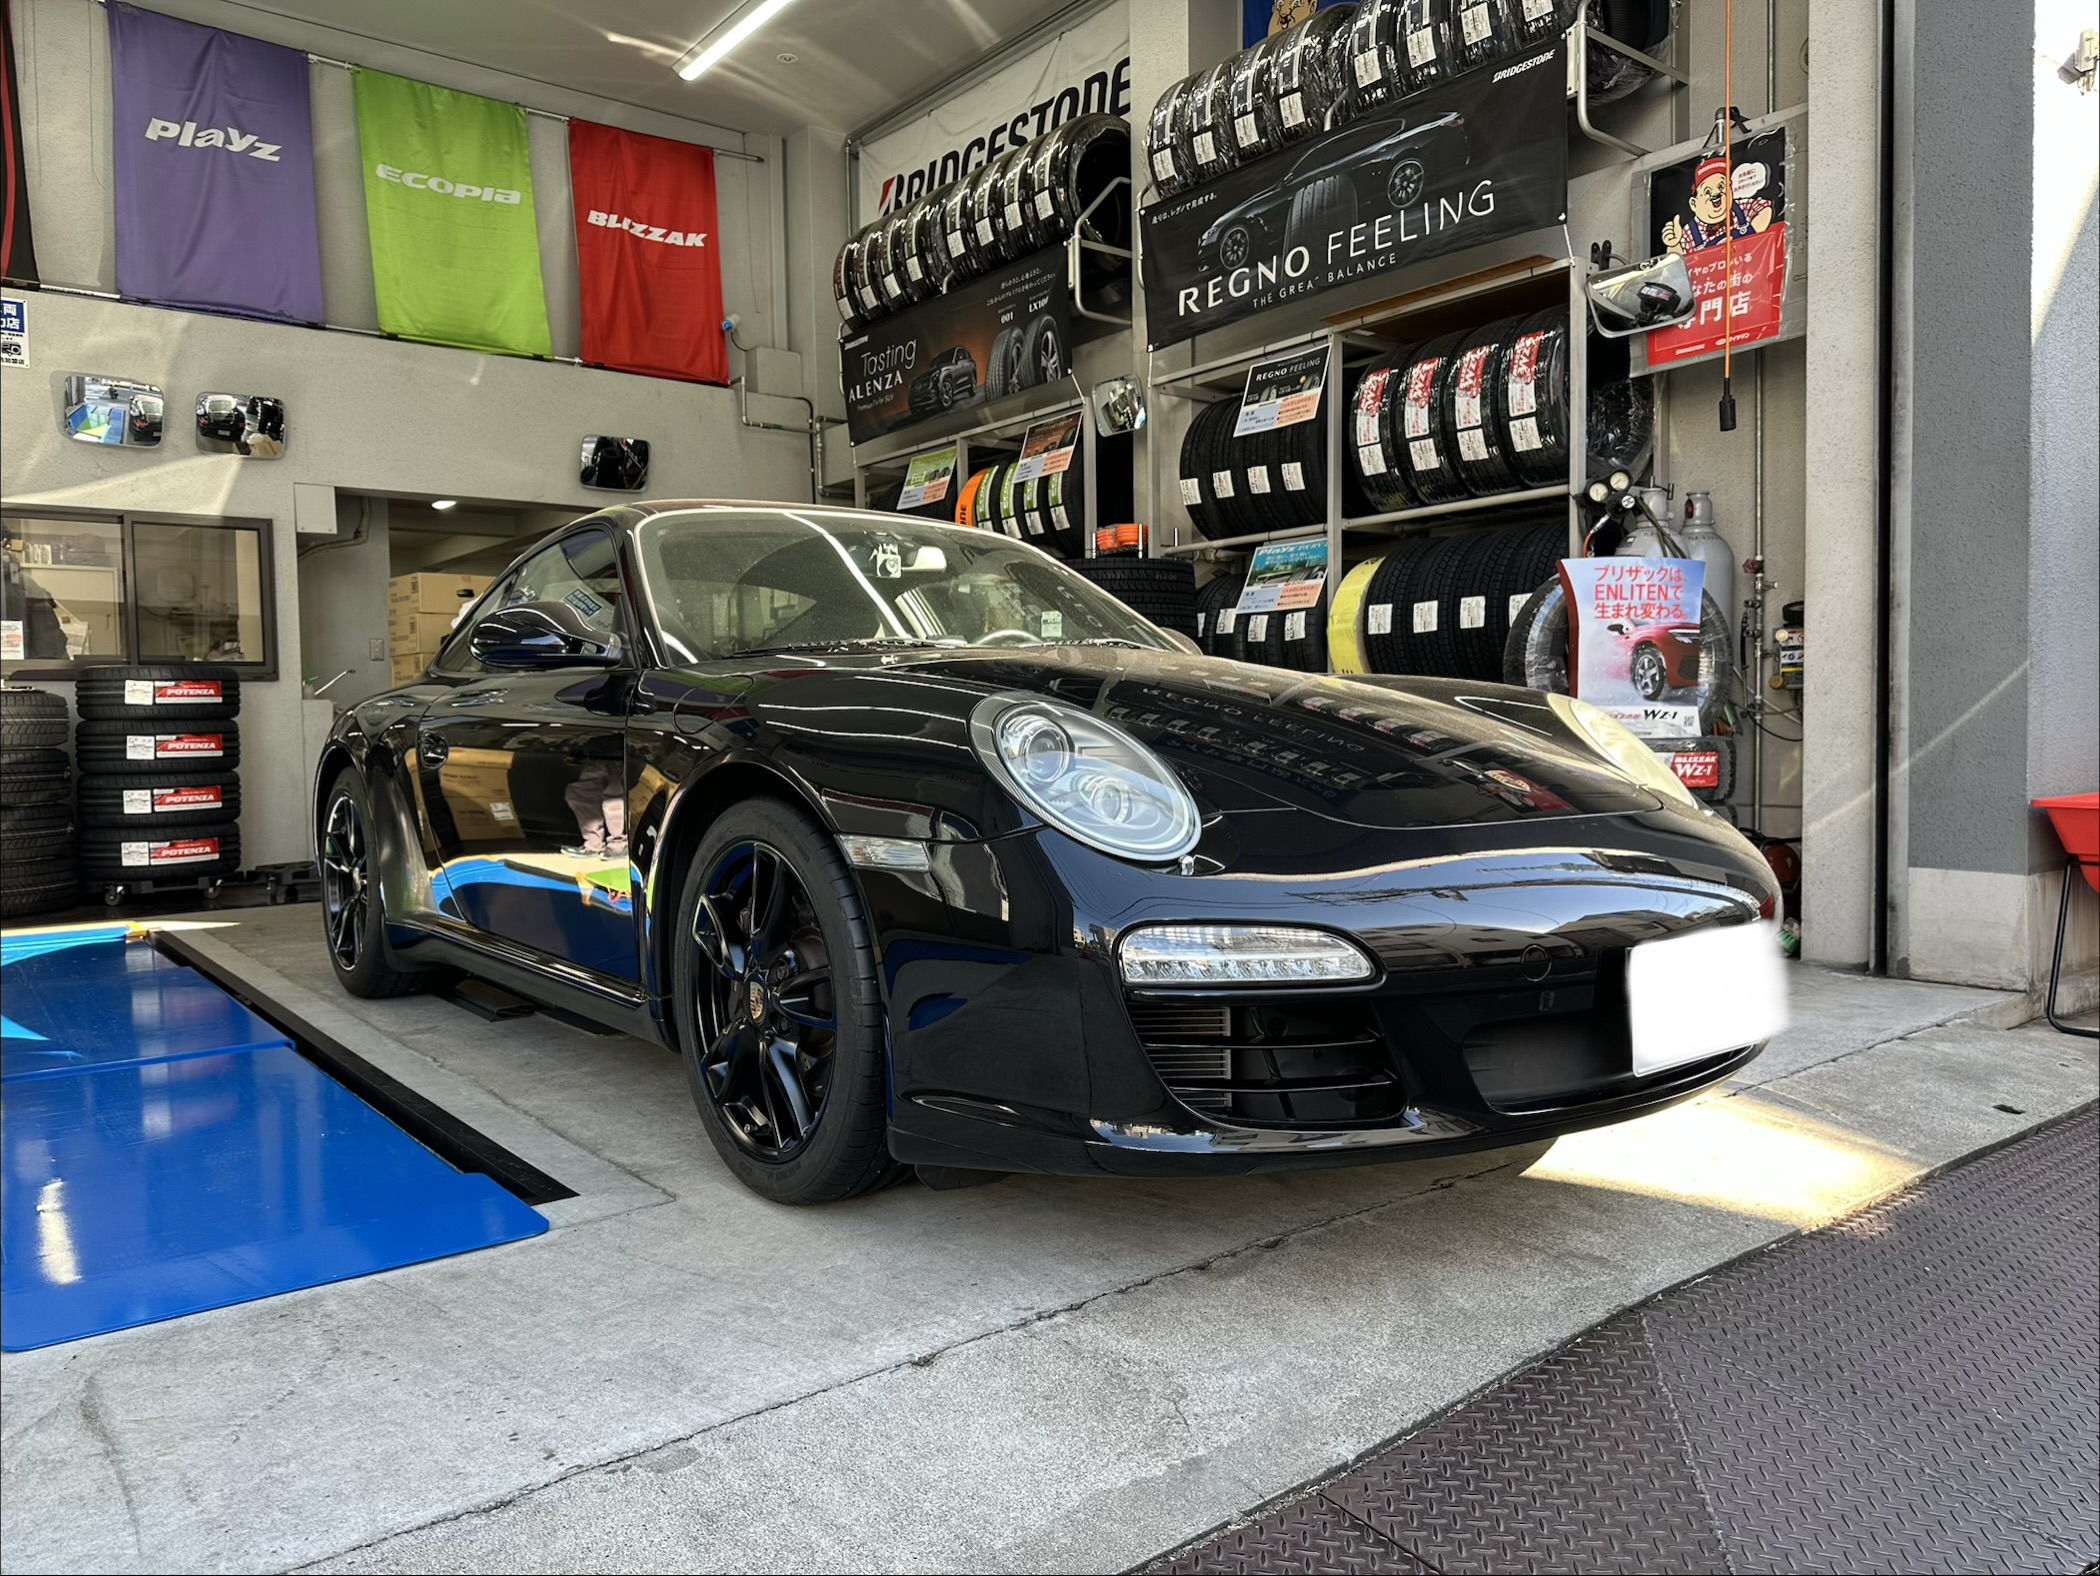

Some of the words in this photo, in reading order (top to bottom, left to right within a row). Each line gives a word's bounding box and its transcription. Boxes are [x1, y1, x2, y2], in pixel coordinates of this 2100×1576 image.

[1492, 49, 1556, 84] BRIDGESTONE
[586, 208, 709, 248] BLIZZAK
[1178, 245, 1311, 317] REGNO
[1326, 179, 1496, 265] FEELING
[1252, 294, 1273, 309] THE
[1279, 276, 1319, 299] GREA
[1327, 252, 1397, 283] BALANCE
[1000, 311, 1014, 324] 001
[1678, 291, 1752, 330] 門店
[861, 339, 917, 377] Tasting
[1256, 368, 1287, 382] REGNO
[1290, 356, 1321, 373] FEELING
[848, 370, 903, 403] ALENZA
[1594, 565, 1687, 583] ブリザックは、
[1595, 584, 1684, 601] ENLITENで
[1594, 602, 1688, 620] 生まれ変わる。
[167, 688, 215, 696] POTENZA
[1644, 709, 1678, 720] WZ-1
[167, 742, 216, 750] POTENZA
[1676, 763, 1713, 778] WZ-1
[165, 794, 214, 803] POTENZA
[161, 846, 211, 856] POTENZA
